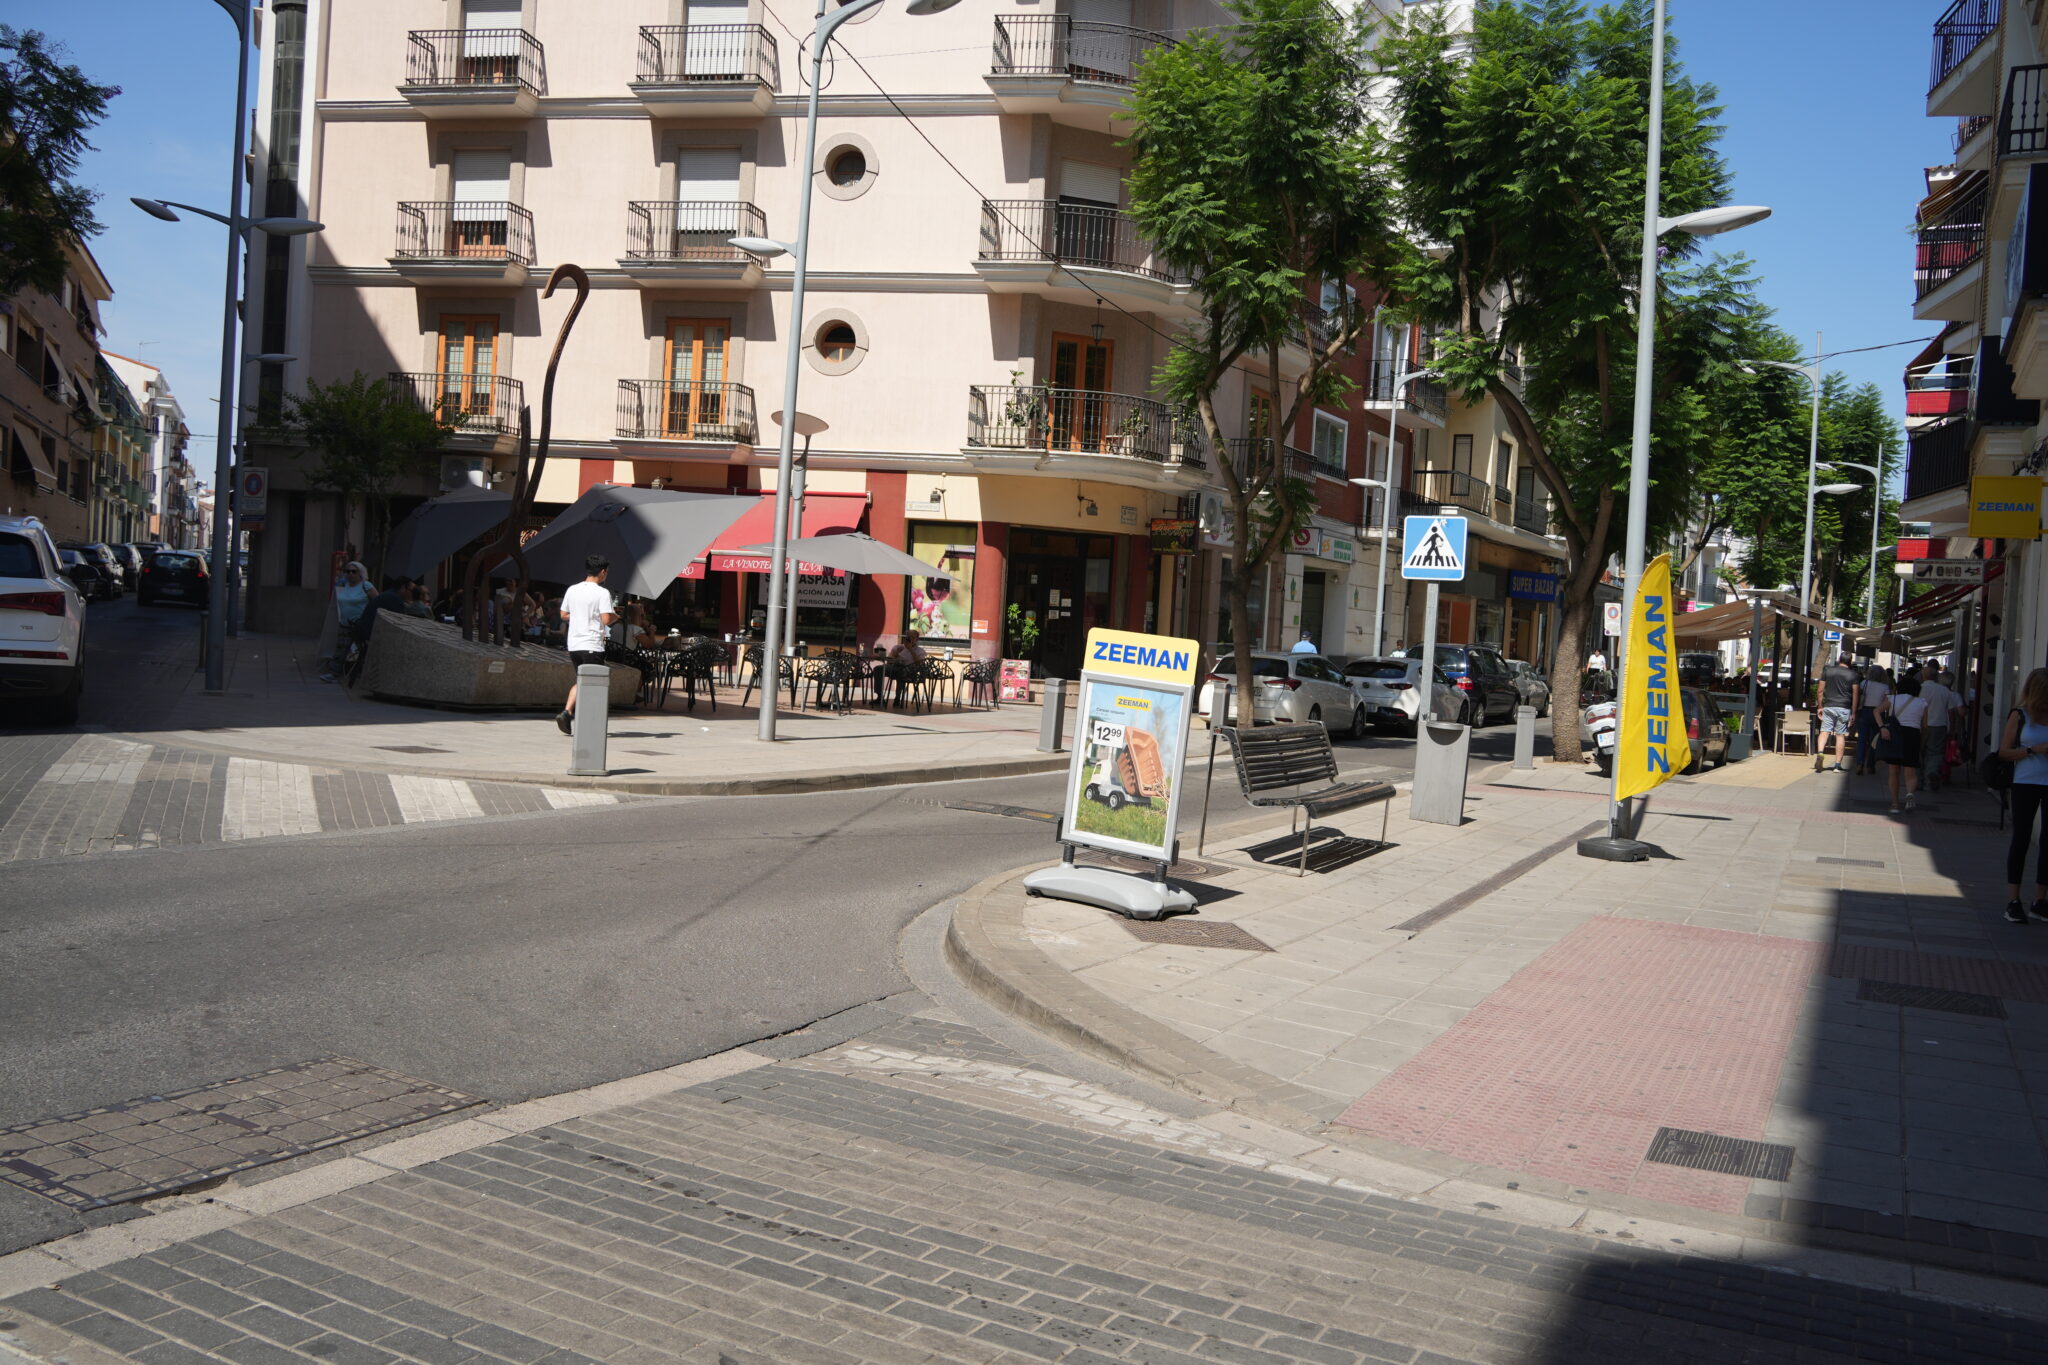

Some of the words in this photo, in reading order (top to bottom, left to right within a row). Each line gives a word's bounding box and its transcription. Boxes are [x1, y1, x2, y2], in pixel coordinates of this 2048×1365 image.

[1976, 502, 2035, 512] ZEEMAN
[736, 559, 773, 570] VINOTE
[784, 574, 845, 586] ASPASA
[1512, 576, 1533, 593] SUPER
[1535, 579, 1555, 595] BAZAR
[1093, 641, 1190, 671] ZEEMAN
[1645, 595, 1671, 773] ZEEMAN
[1118, 698, 1149, 709] ZEEMAN
